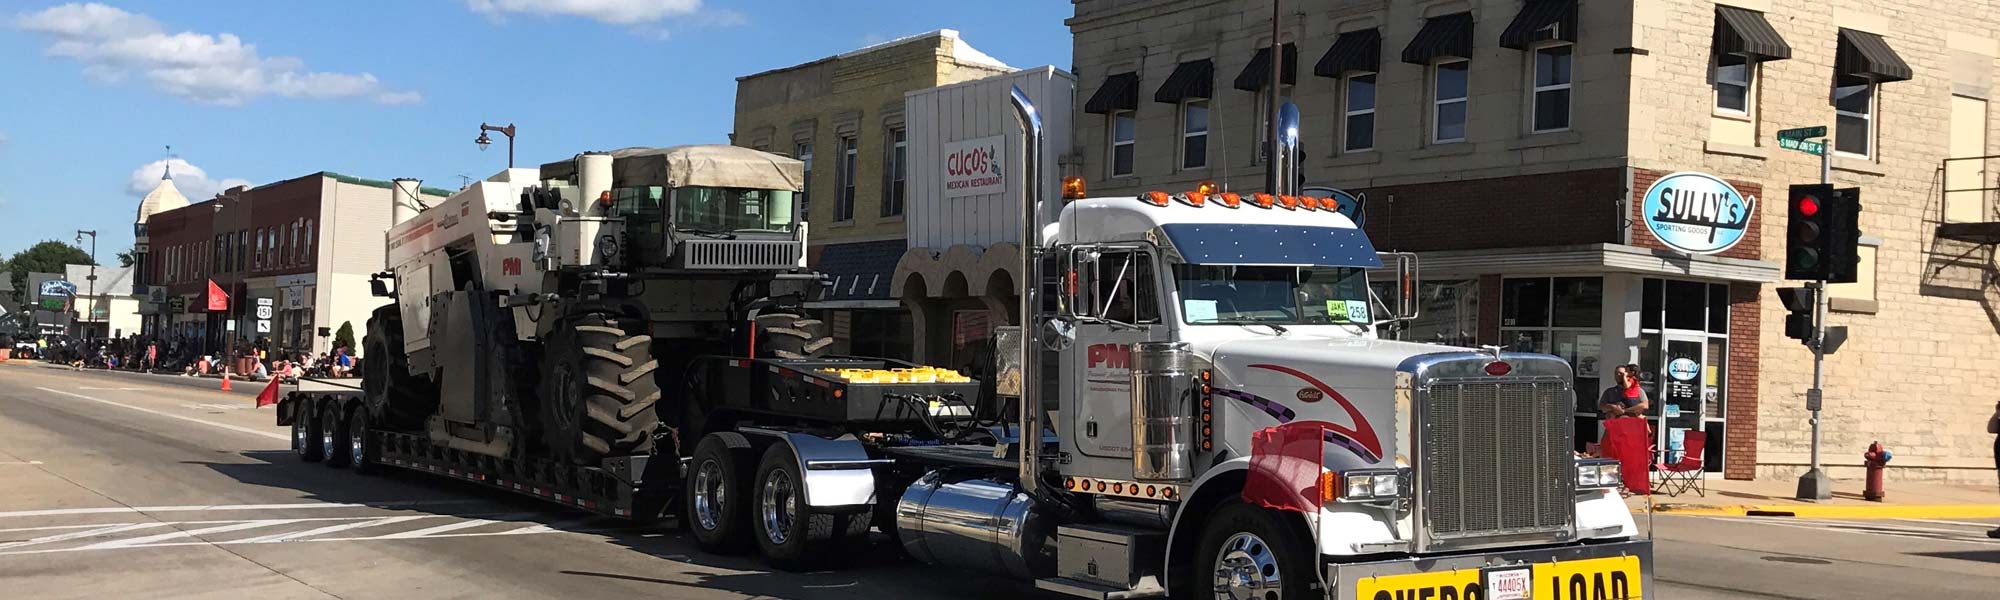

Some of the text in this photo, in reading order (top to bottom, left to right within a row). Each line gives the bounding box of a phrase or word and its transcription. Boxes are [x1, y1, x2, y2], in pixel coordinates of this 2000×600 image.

[1780, 138, 1785, 147] S
[1808, 142, 1816, 152] ST
[947, 176, 1003, 190] MEXICAN RESTAURANT
[1656, 223, 1687, 233] SPORTING
[1687, 226, 1708, 235] GOODS
[259, 307, 271, 317] 151
[1350, 306, 1366, 319] 258
[1498, 577, 1527, 592] 44405X
